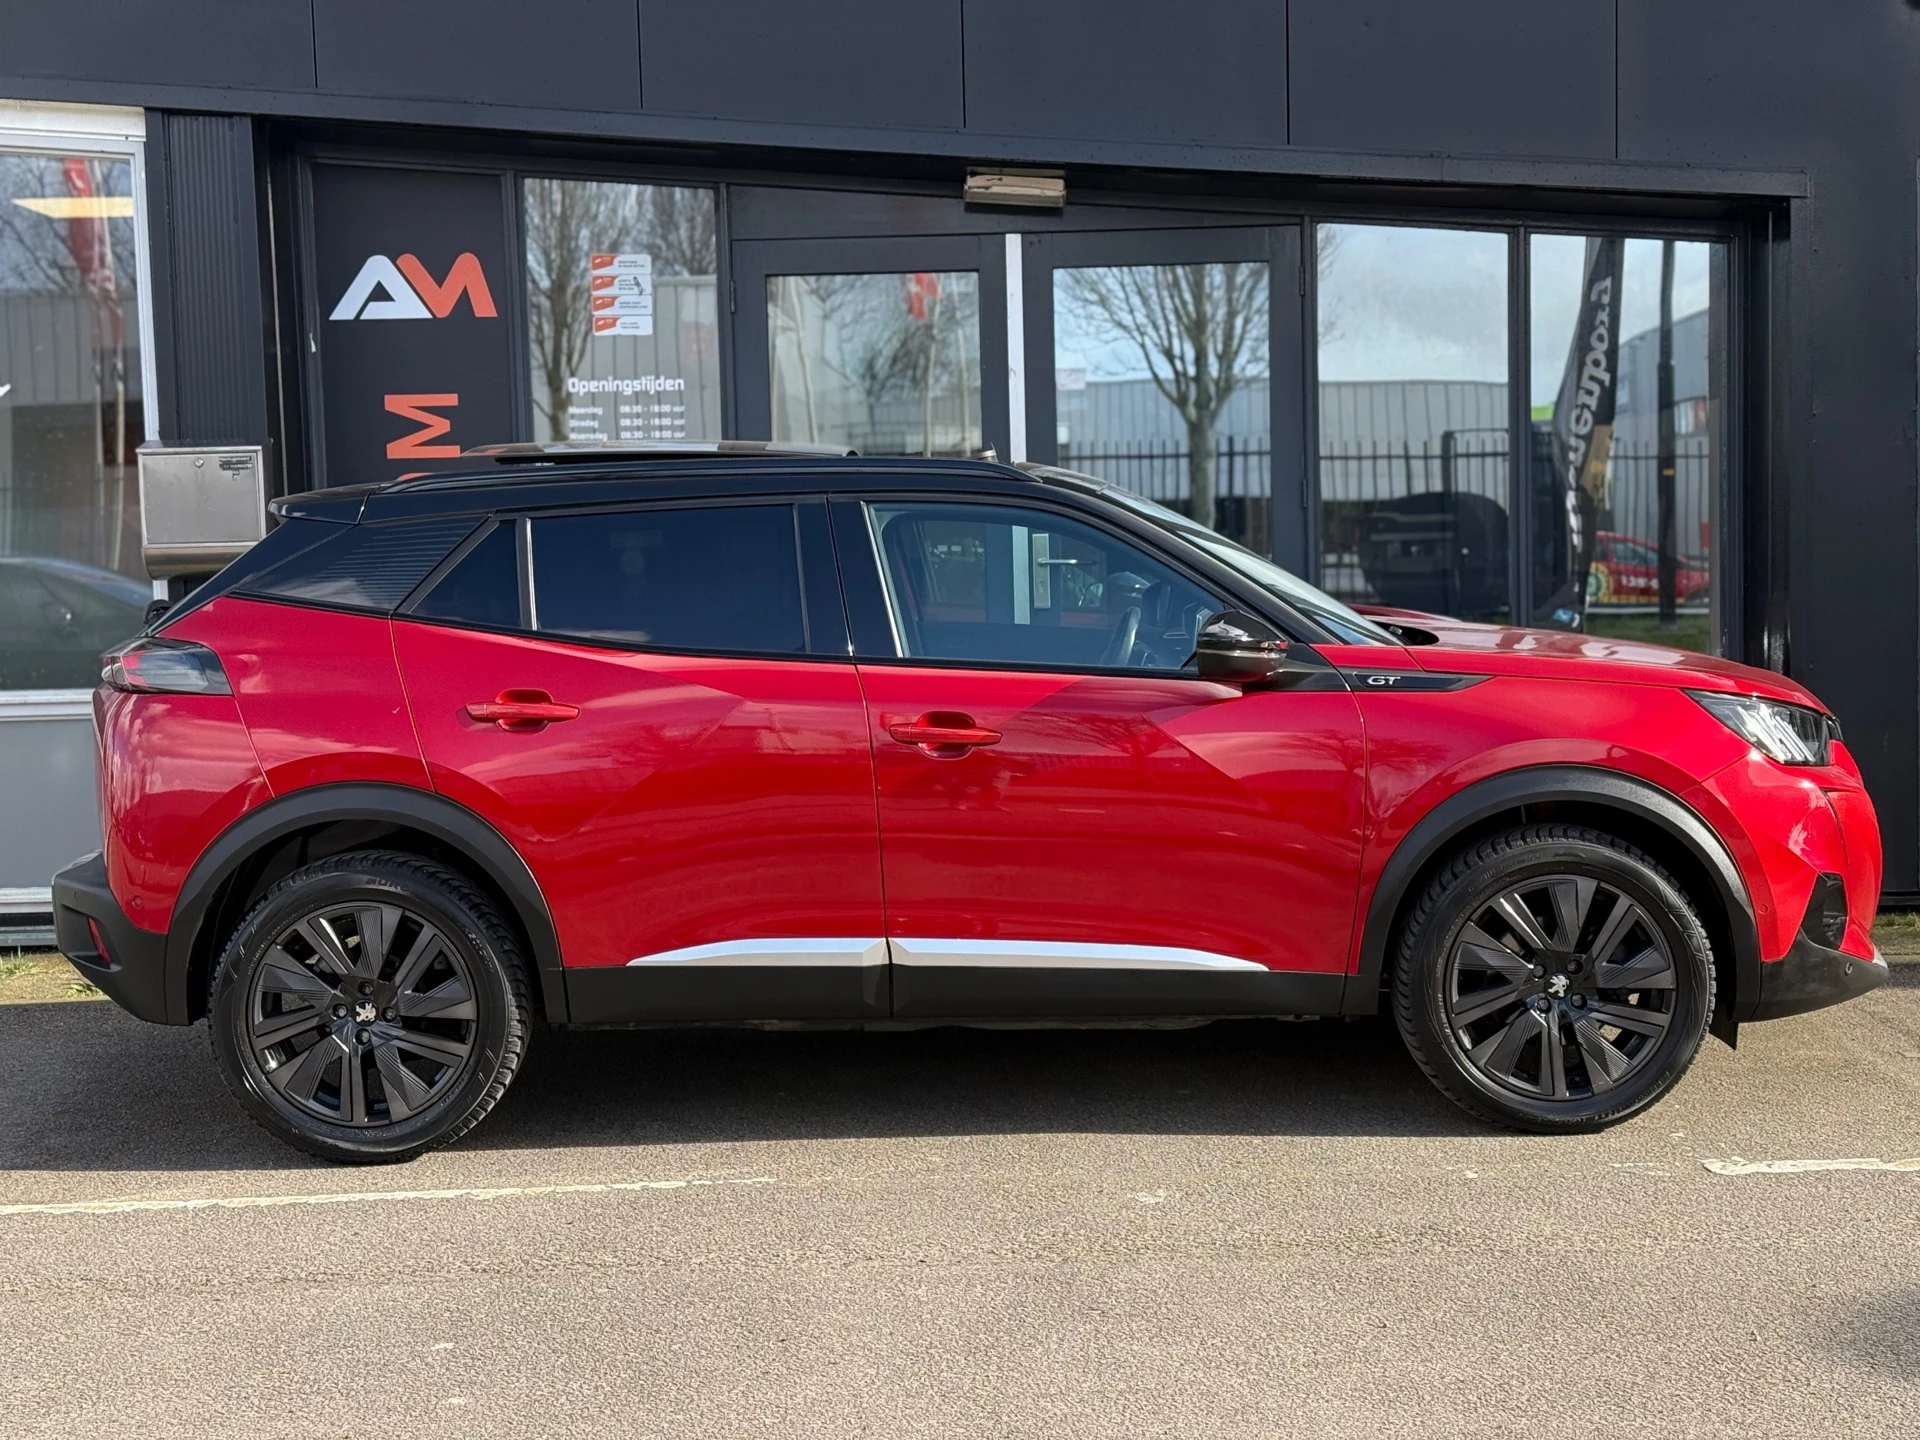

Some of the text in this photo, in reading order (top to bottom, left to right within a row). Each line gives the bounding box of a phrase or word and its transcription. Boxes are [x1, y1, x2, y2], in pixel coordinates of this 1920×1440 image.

[329, 252, 498, 320] AM
[568, 376, 685, 396] Openingstijden
[1367, 675, 1401, 685] GT
